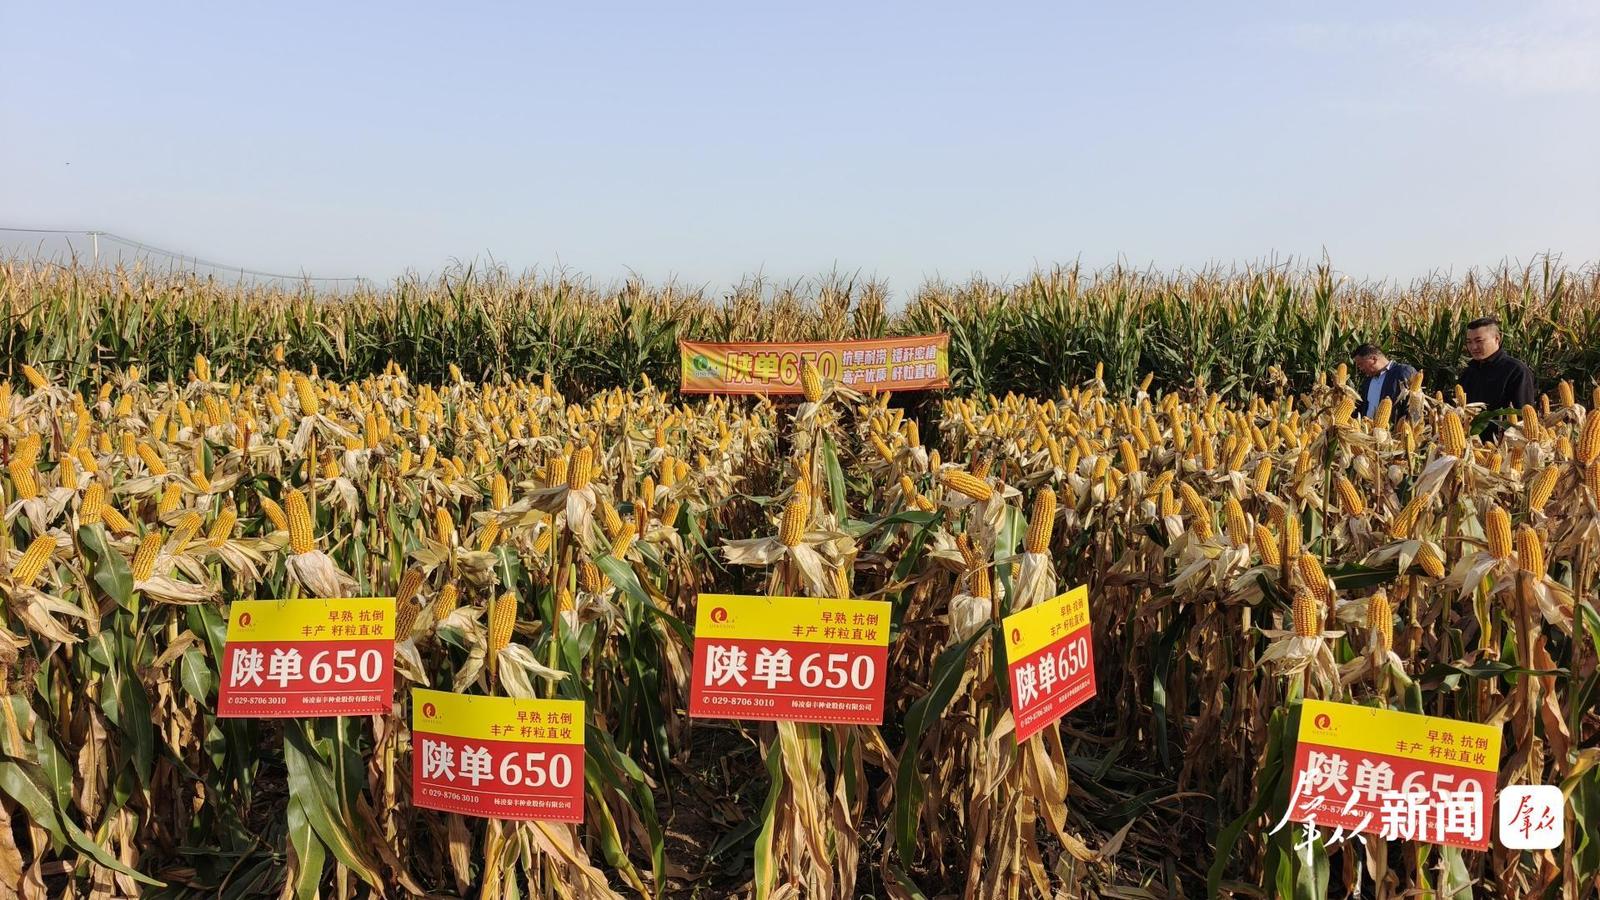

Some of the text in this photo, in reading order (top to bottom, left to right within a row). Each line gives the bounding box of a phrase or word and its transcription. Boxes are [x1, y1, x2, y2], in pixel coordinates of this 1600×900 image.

[842, 367, 888, 384] 高产优质
[328, 609, 384, 622] 早熟 抗倒
[820, 612, 879, 626] 早熟 抗倒
[302, 624, 384, 637] 丰产 籽粒直收
[792, 625, 877, 641] 丰产 籽粒直收
[229, 647, 383, 688] 陕单650
[704, 644, 876, 690] 陕单650
[1015, 636, 1089, 711] 陕单650
[234, 696, 286, 705] 029-8706 3010
[712, 696, 775, 707] 029-8706 3010
[517, 711, 573, 725] 早熟 抗倒
[490, 725, 572, 739] 丰产 籽粒直收
[1426, 730, 1489, 750] 早熟 抗倒
[1395, 740, 1487, 766] 丰产 籽粒直收
[421, 738, 572, 788] 陕单650
[428, 788, 479, 804] 029-8706 3010
